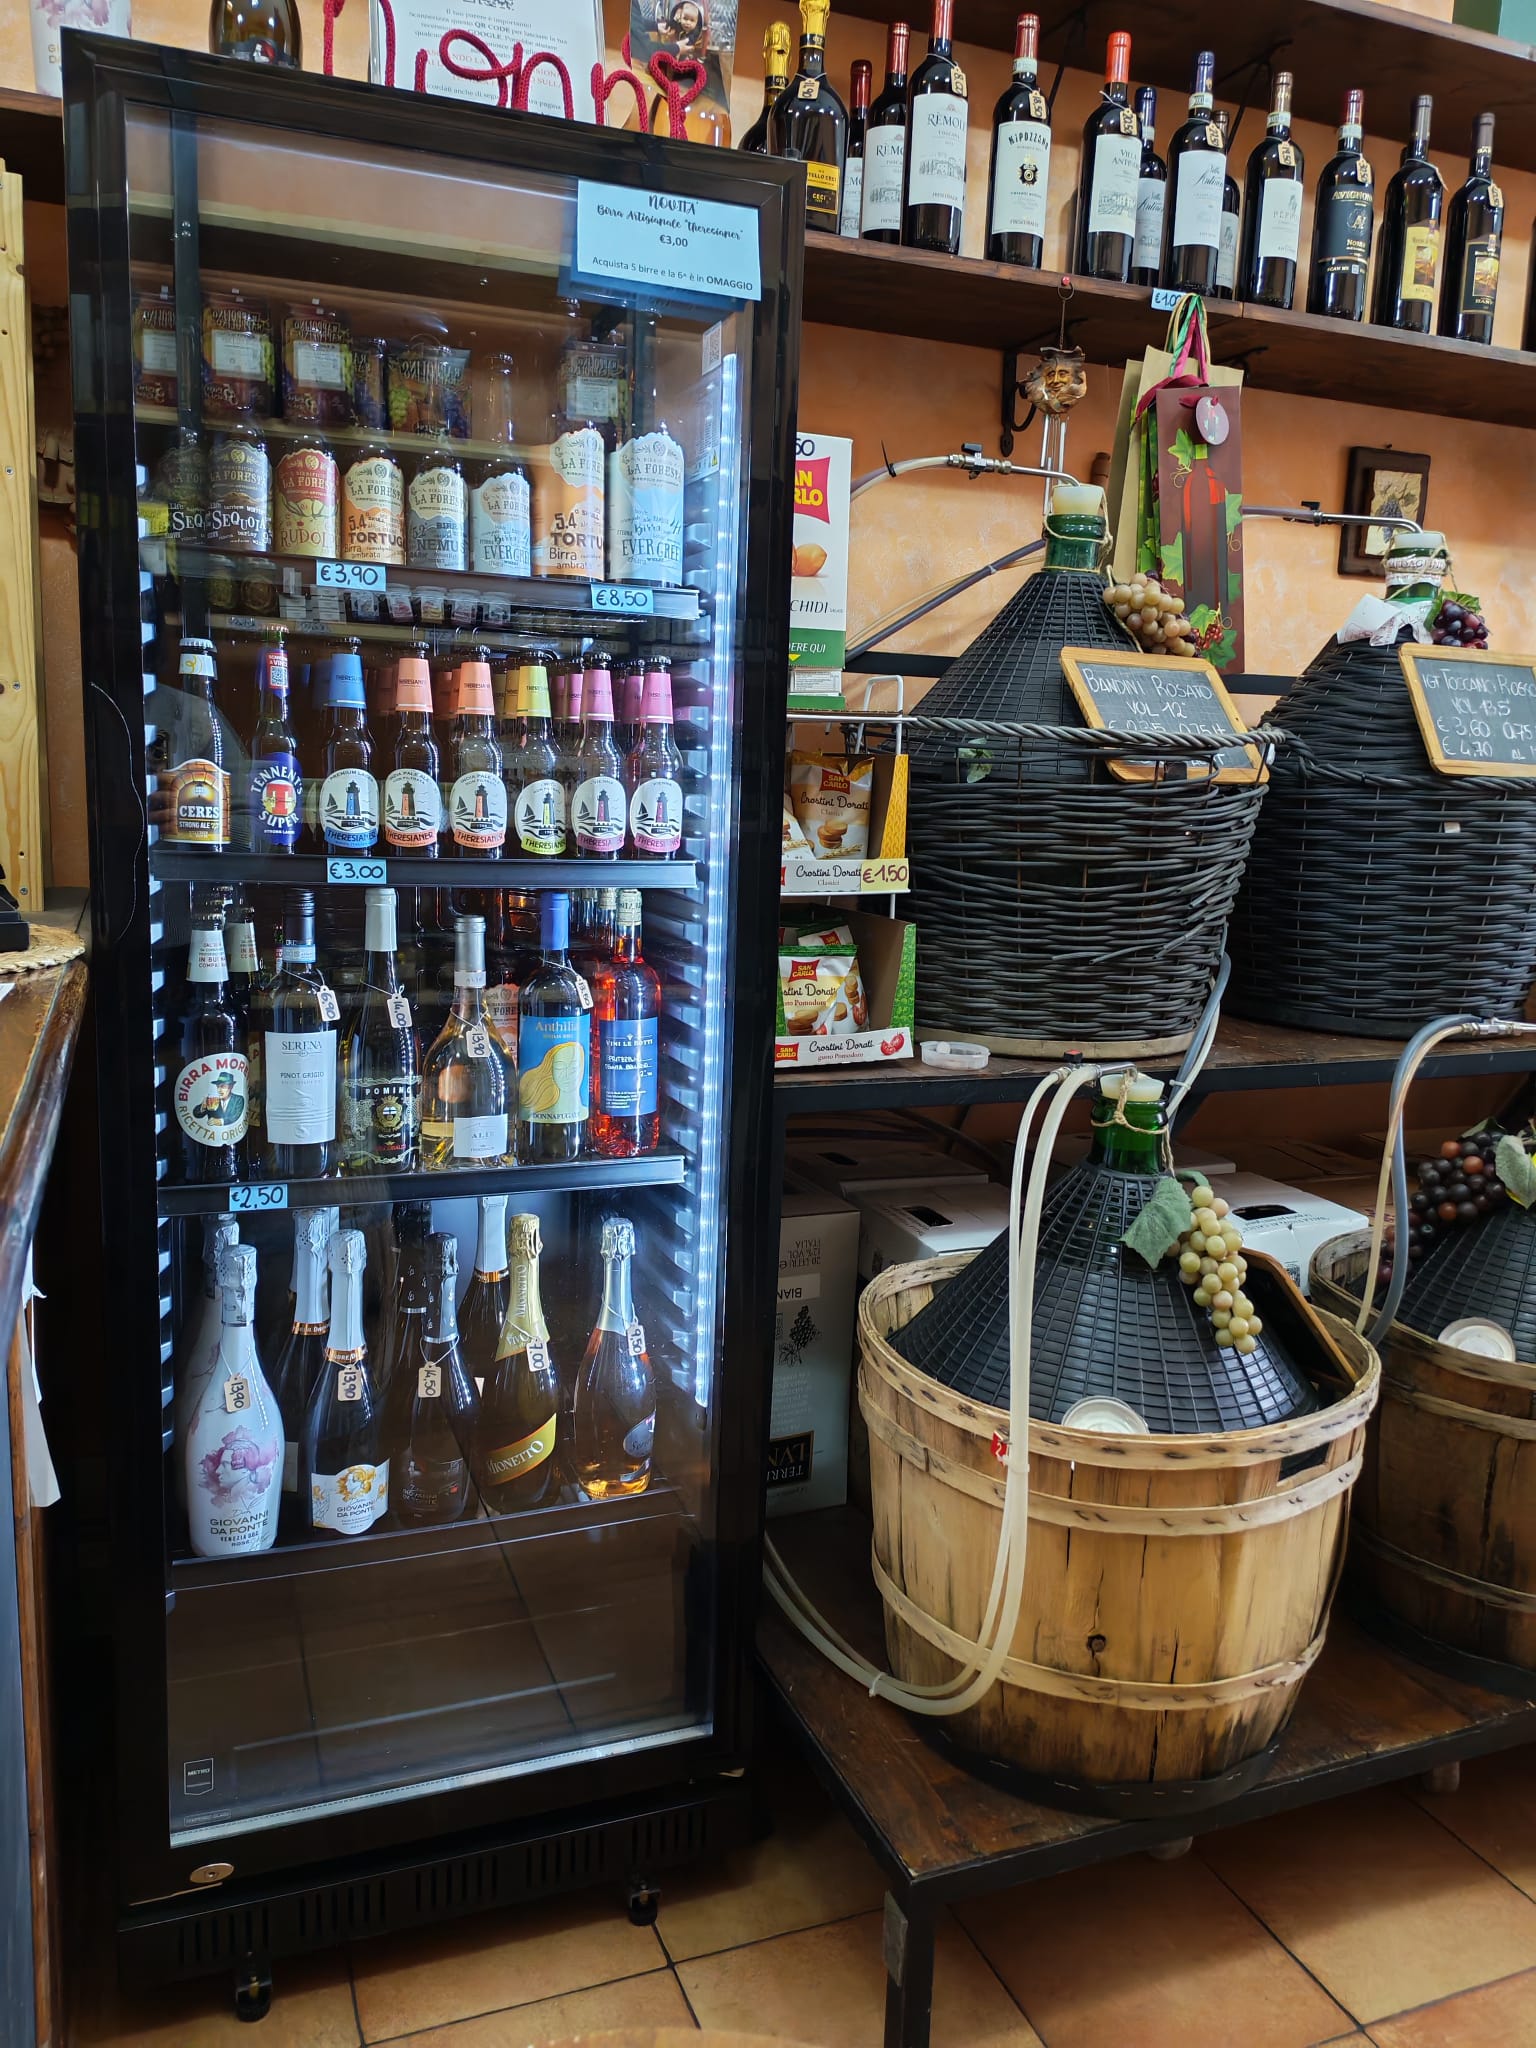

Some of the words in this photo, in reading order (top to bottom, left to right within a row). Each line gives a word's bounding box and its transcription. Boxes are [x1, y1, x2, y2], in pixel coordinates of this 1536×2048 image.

[474, 20, 486, 30] QR
[486, 22, 511, 33] CODE
[626, 210, 682, 230] Artigianale
[660, 234, 688, 248] €3,00
[592, 256, 629, 271] Acquista
[631, 263, 636, 271] 5
[638, 262, 659, 276] birre
[668, 269, 675, 278] la
[689, 273, 695, 281] è
[696, 274, 705, 283] in
[706, 275, 753, 291] OMAGGIO
[559, 458, 577, 470] LA
[795, 471, 812, 487] AN
[795, 489, 823, 506] RLO
[549, 547, 577, 561] Birra
[320, 563, 378, 586] €3,90
[596, 589, 648, 608] €8,50
[790, 599, 828, 613] CHIDI
[809, 643, 826, 653] QUI
[1082, 667, 1145, 695] BANDINI
[1151, 675, 1213, 699] ROSATO
[1421, 673, 1440, 689] IGT
[1127, 701, 1159, 718] VOL
[1436, 716, 1450, 732] €
[1442, 736, 1457, 756] €
[250, 765, 304, 795] TENNENT'S
[822, 781, 849, 789] CARLO
[828, 774, 845, 782] SAN
[800, 791, 834, 807] Crostini
[837, 795, 869, 809] Dorati
[179, 805, 220, 818] CERES
[179, 821, 200, 829] STRONG
[200, 821, 211, 829] ALE
[258, 810, 300, 828] SUPER
[327, 830, 378, 842] THERESIANER
[386, 830, 434, 842] THERESIANER
[796, 864, 830, 878] Crostini
[833, 864, 861, 878] Dorati
[792, 969, 815, 977] CARLO
[783, 984, 803, 996] stini
[281, 1039, 322, 1051] SERENA
[623, 1039, 632, 1047] LE
[809, 1041, 843, 1053] Crostini
[845, 1038, 874, 1051] Dorati
[834, 1052, 864, 1060] Pomodoro
[178, 1062, 213, 1102] BIRRA
[302, 1071, 325, 1079] GRIGIO
[365, 1086, 412, 1096] POMINO
[179, 1105, 216, 1141] RICETTA
[796, 1239, 821, 1249] ITALIA
[342, 1371, 357, 1399] 13,90
[487, 1439, 544, 1474] MIONETTO
[337, 1501, 375, 1512] GIOVANNI
[348, 1506, 374, 1517] PONTE
[210, 1510, 269, 1527] GIOVANNI
[210, 1527, 227, 1536] DA
[229, 1519, 268, 1534] PONTE
